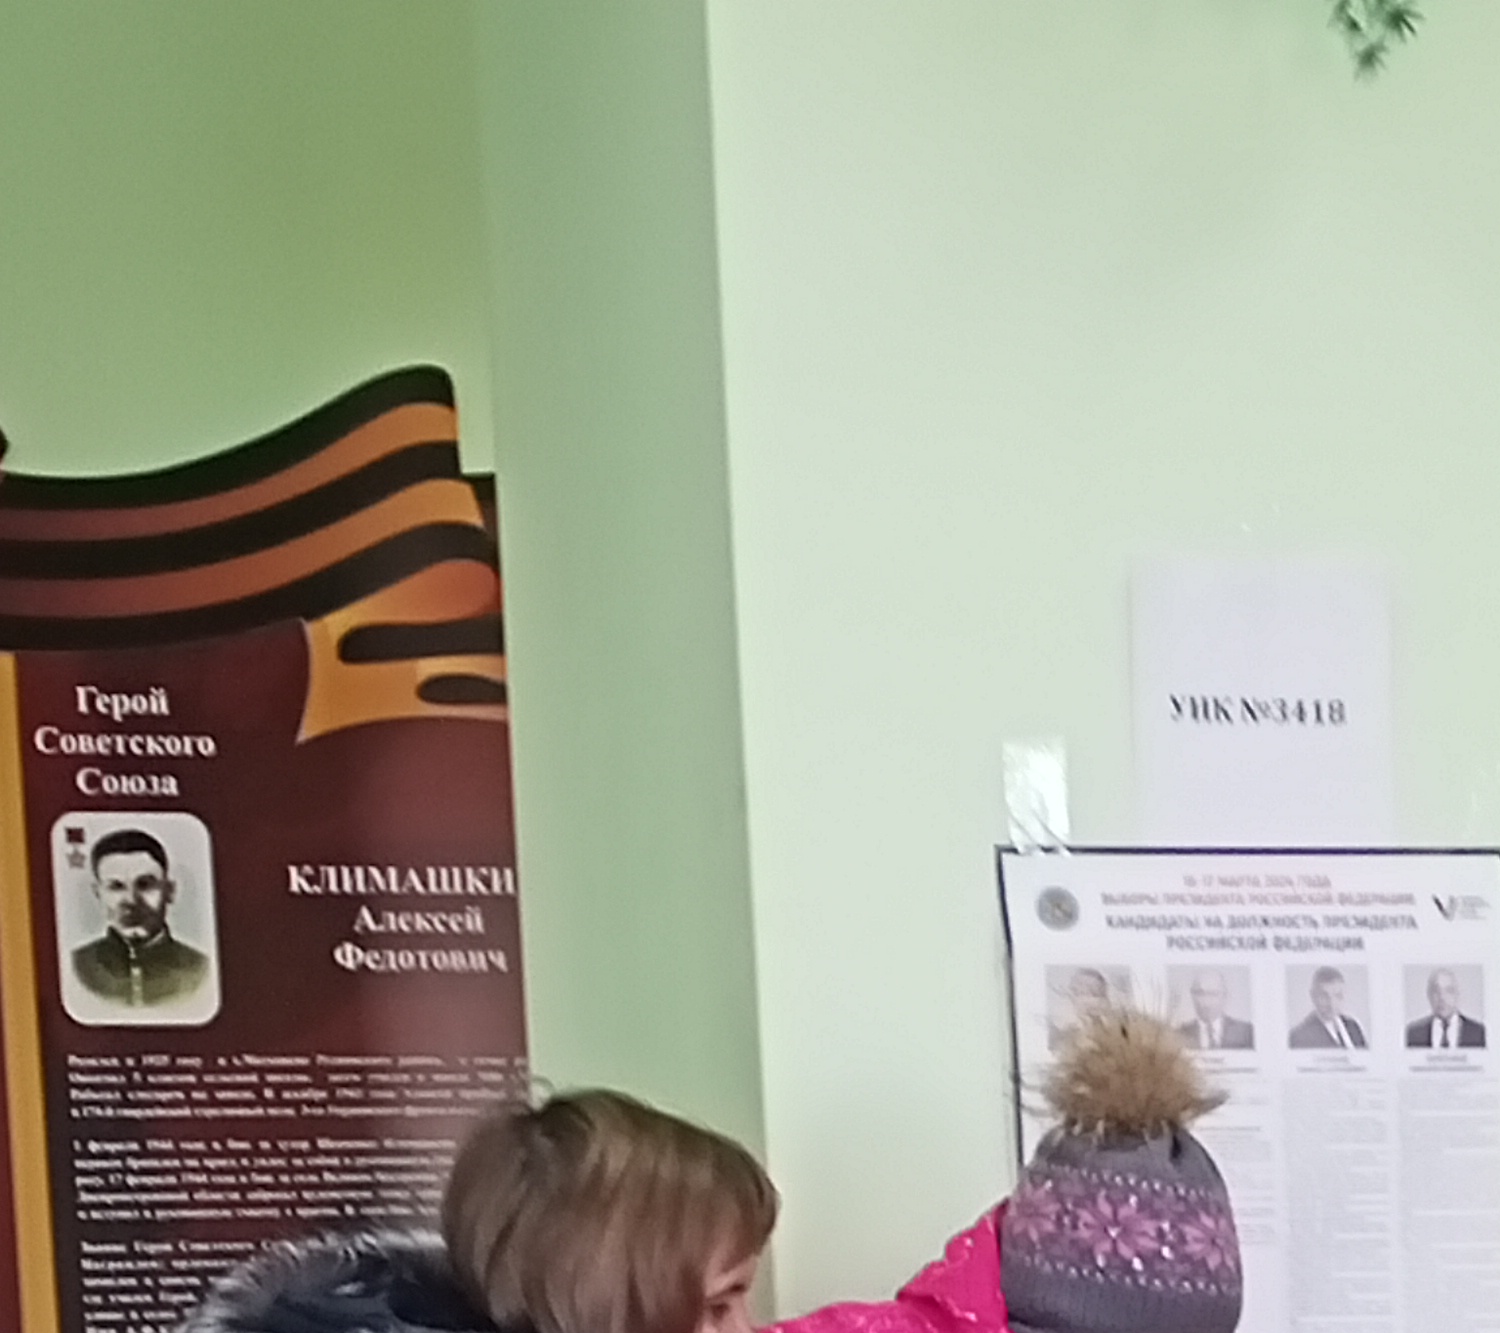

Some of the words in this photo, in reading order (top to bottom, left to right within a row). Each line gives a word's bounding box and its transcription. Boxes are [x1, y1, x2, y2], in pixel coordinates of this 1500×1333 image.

[75, 685, 170, 722] Герой
[1169, 693, 1233, 726] УИК
[33, 725, 217, 757] Советского
[75, 766, 180, 796] Союза
[353, 904, 485, 934] Алексей
[333, 941, 508, 973] Федотович
